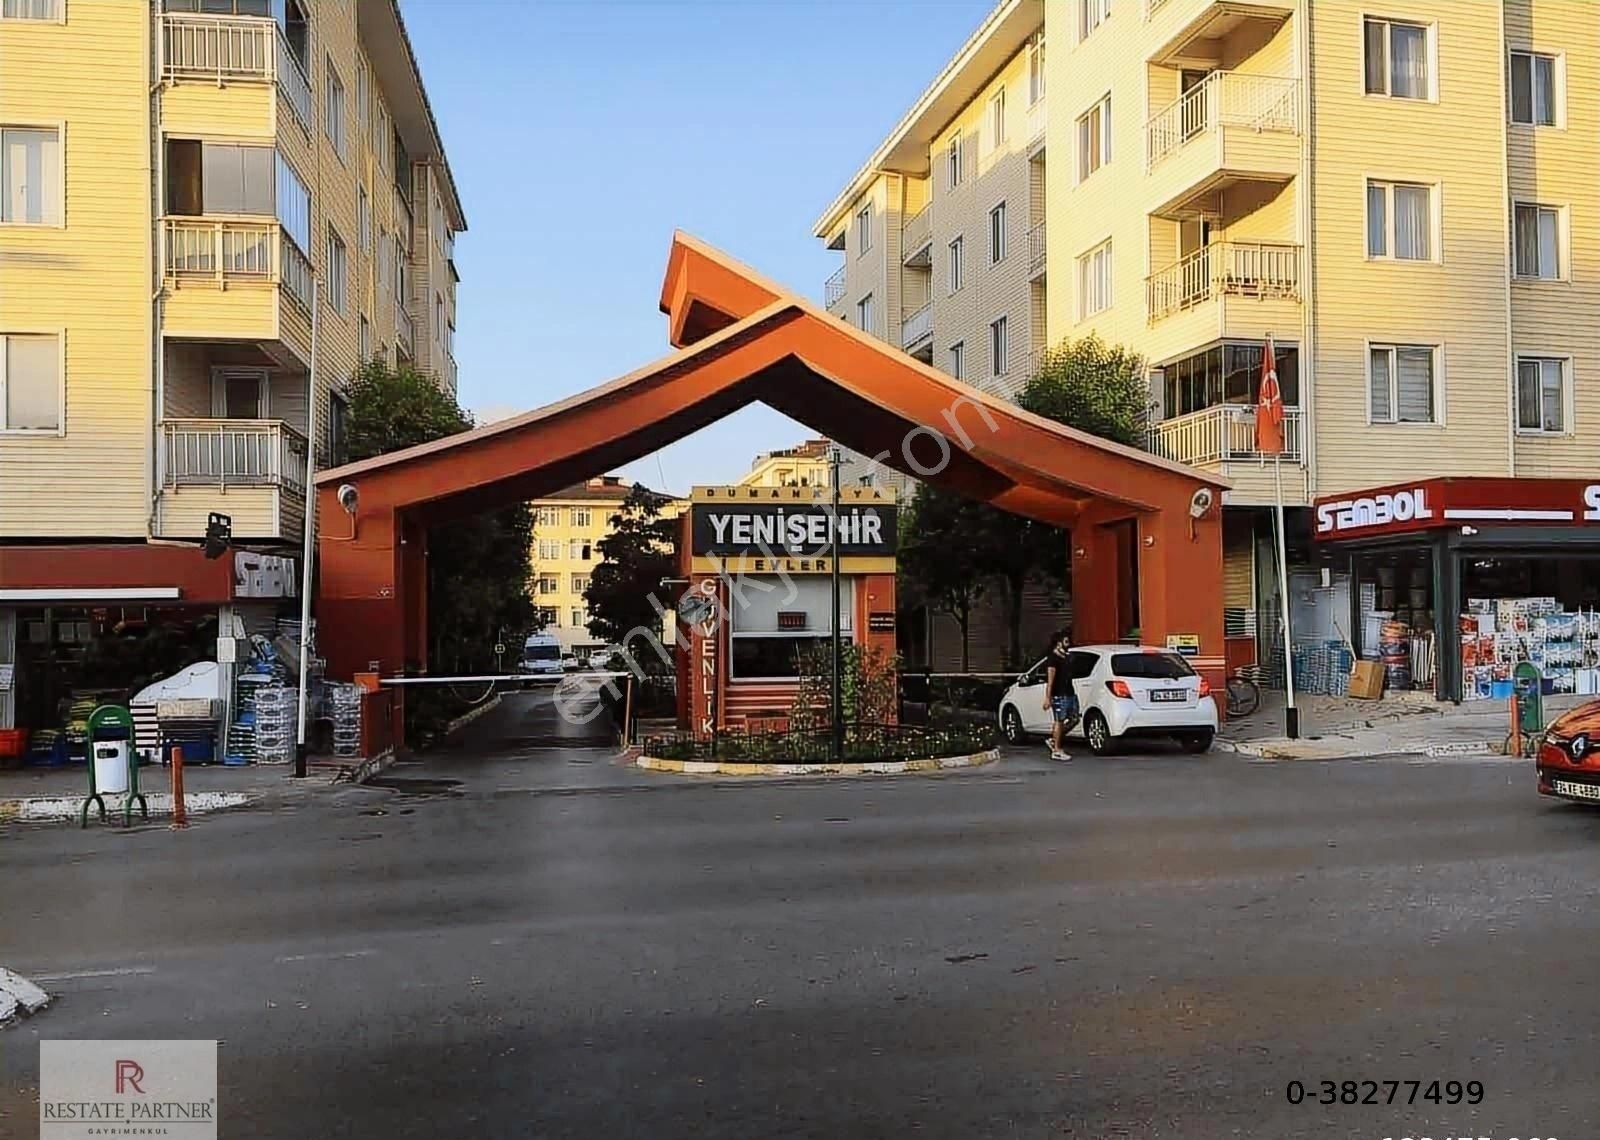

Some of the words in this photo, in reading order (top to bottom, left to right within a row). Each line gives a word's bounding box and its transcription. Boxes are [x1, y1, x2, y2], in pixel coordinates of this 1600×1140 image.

[708, 508, 882, 552] YENİŞEHİR
[1317, 489, 1432, 532] SEMBOL
[755, 559, 826, 571] EVLER
